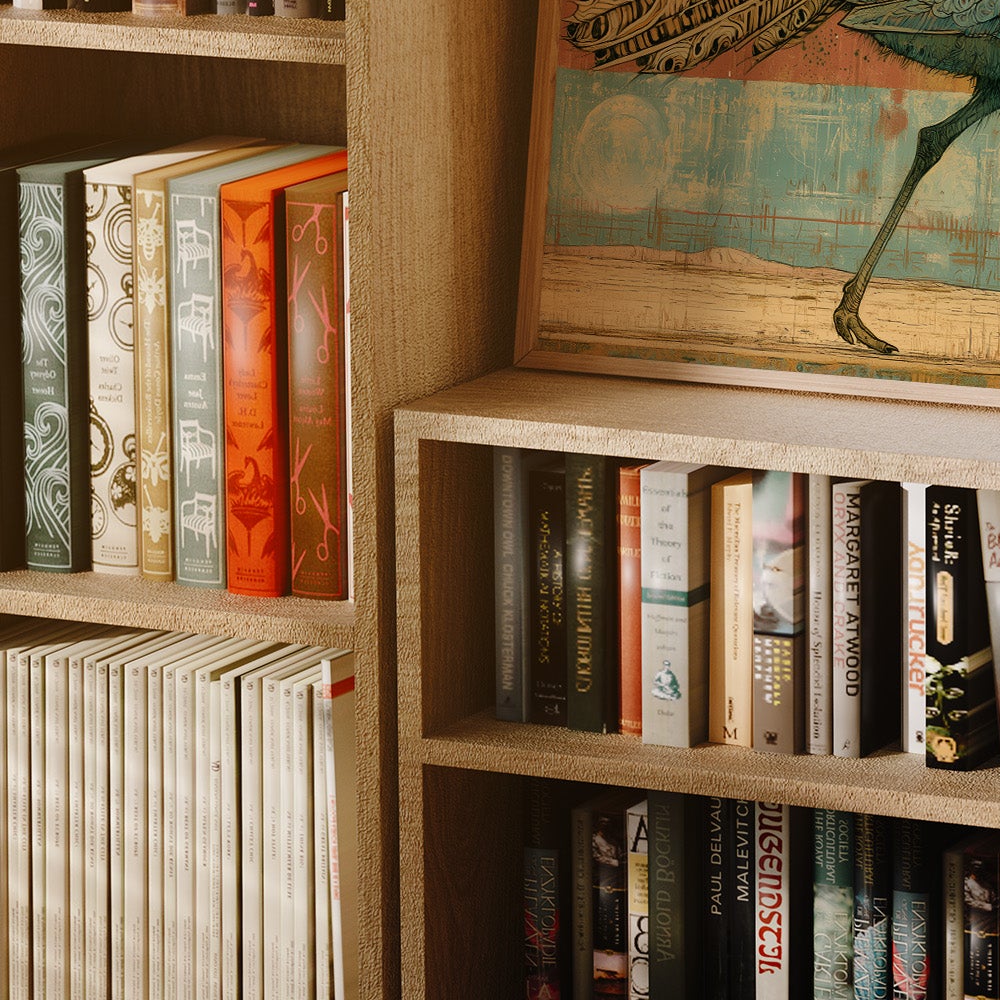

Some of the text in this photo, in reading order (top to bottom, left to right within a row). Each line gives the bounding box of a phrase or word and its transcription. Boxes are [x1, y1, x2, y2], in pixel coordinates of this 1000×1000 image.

[833, 492, 845, 669] ORYX AND CRAKE
[846, 493, 860, 697] MARGARET ATWOOD
[711, 871, 723, 916] PAUL
